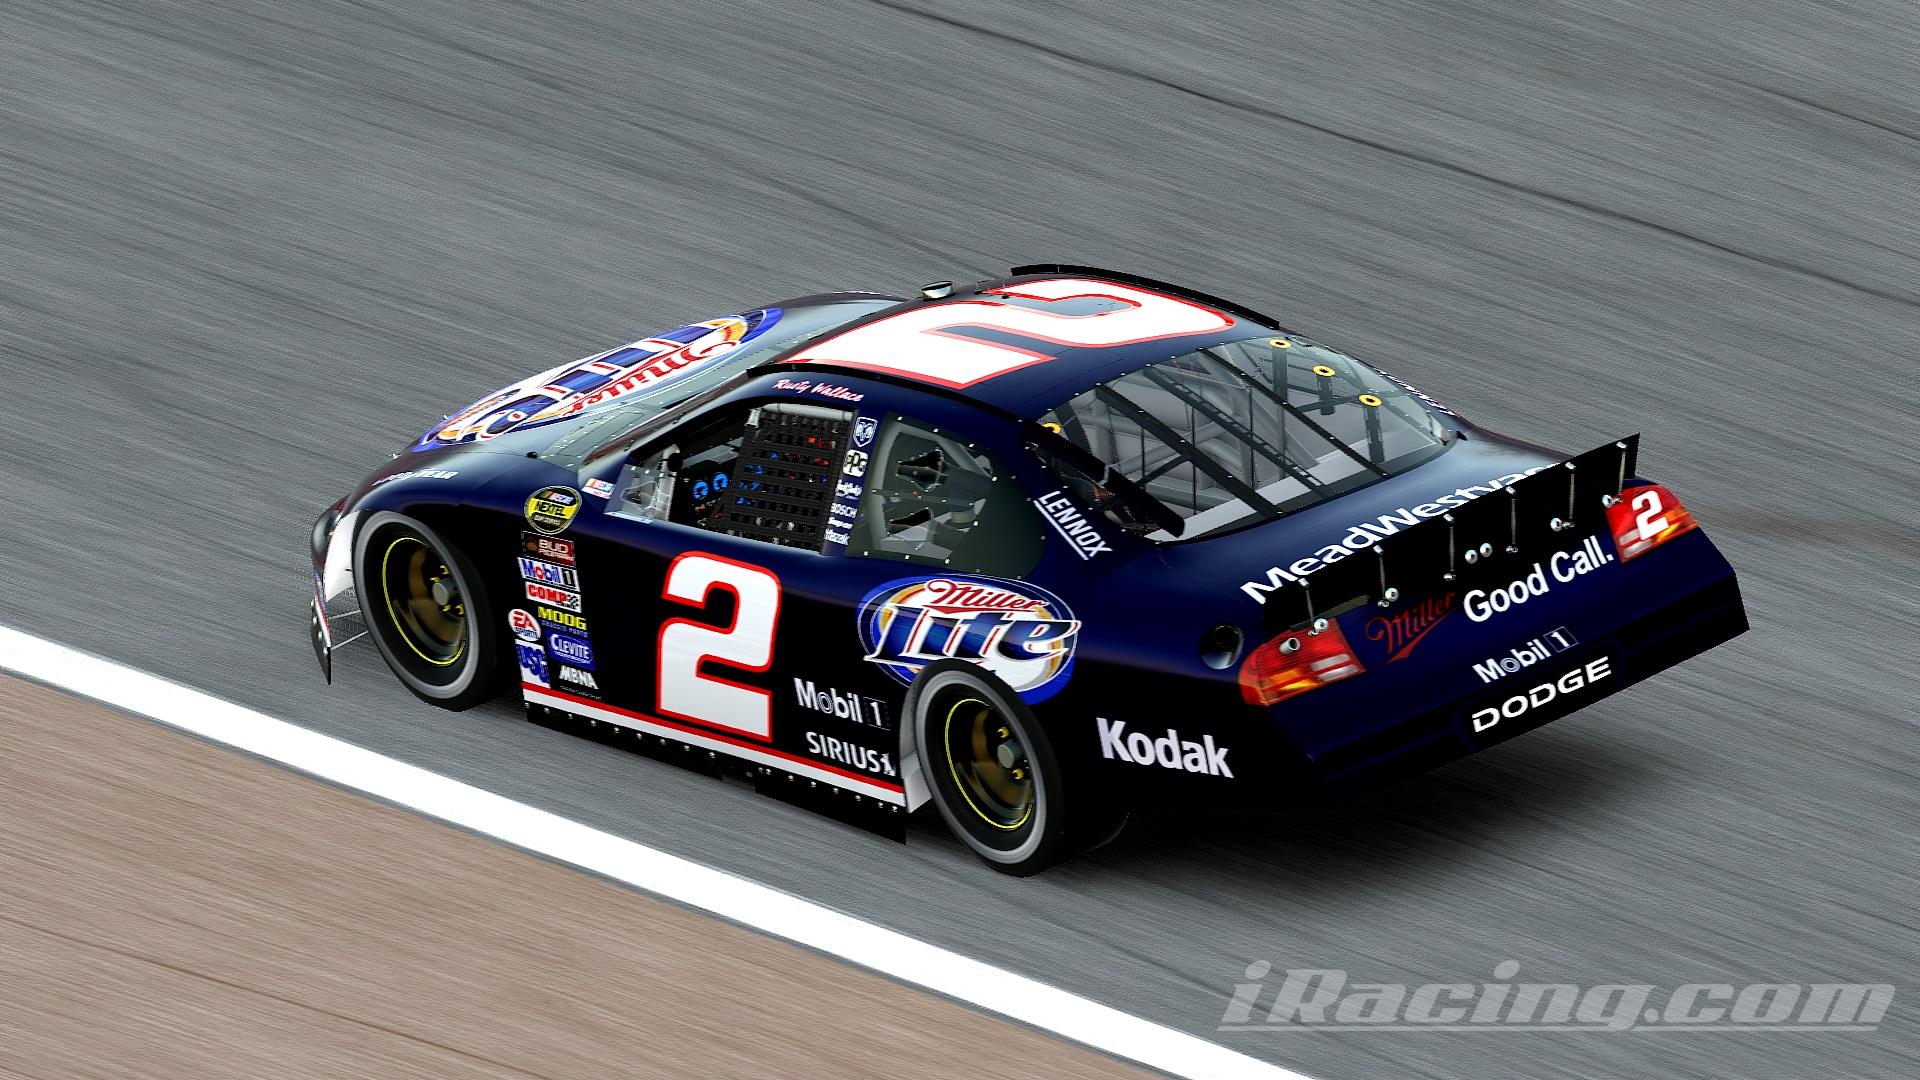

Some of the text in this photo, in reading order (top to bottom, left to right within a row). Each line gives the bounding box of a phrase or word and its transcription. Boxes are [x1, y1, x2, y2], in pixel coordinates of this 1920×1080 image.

[778, 278, 1236, 390] 2
[562, 341, 737, 416] Miller
[772, 379, 865, 402] Rusty Wallace
[1038, 490, 1113, 558] LENNOX
[1240, 462, 1561, 605] MeadWestva
[1631, 490, 1670, 541] 2
[538, 538, 569, 554] BUD
[521, 558, 560, 584] Mobil
[527, 584, 567, 603] COMP
[1463, 535, 1615, 622] Good Call.
[537, 606, 587, 631] MOOG
[925, 579, 1047, 614] Miller
[513, 610, 538, 632] EA
[864, 602, 1082, 665] Lite
[1365, 591, 1457, 660] Miller
[550, 633, 590, 660] CLEVITE
[656, 550, 783, 742] 2
[1472, 638, 1552, 683] Mobil
[558, 664, 600, 690] MBNA
[794, 677, 864, 724] Mobil
[1471, 655, 1612, 733] DODGE
[806, 731, 881, 773] SIRIUS
[1096, 717, 1235, 779] Kodak
